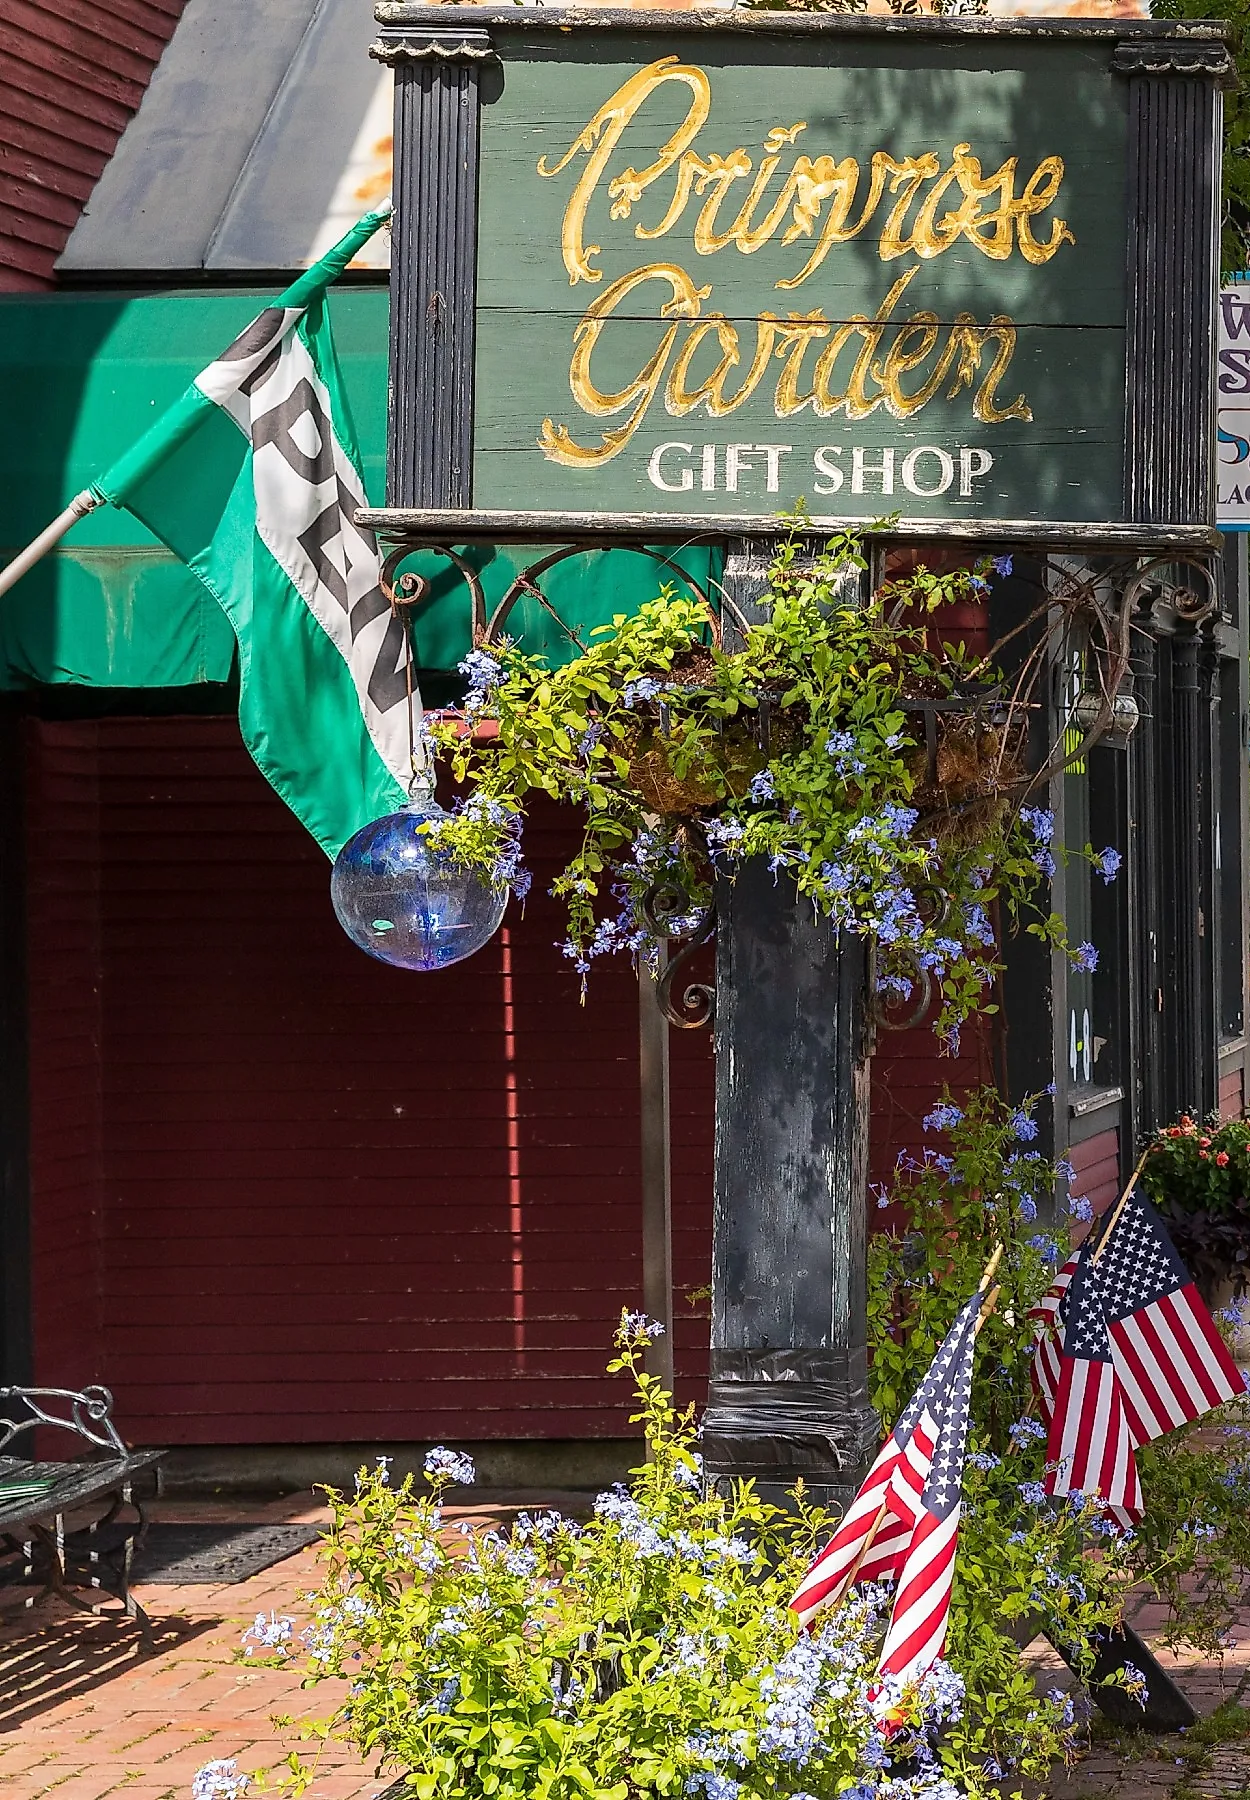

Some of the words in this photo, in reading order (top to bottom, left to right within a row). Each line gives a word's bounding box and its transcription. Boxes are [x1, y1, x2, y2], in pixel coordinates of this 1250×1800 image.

[537, 263, 1034, 468] Garden
[648, 442, 793, 492] GIFT
[813, 446, 994, 497] SHOP
